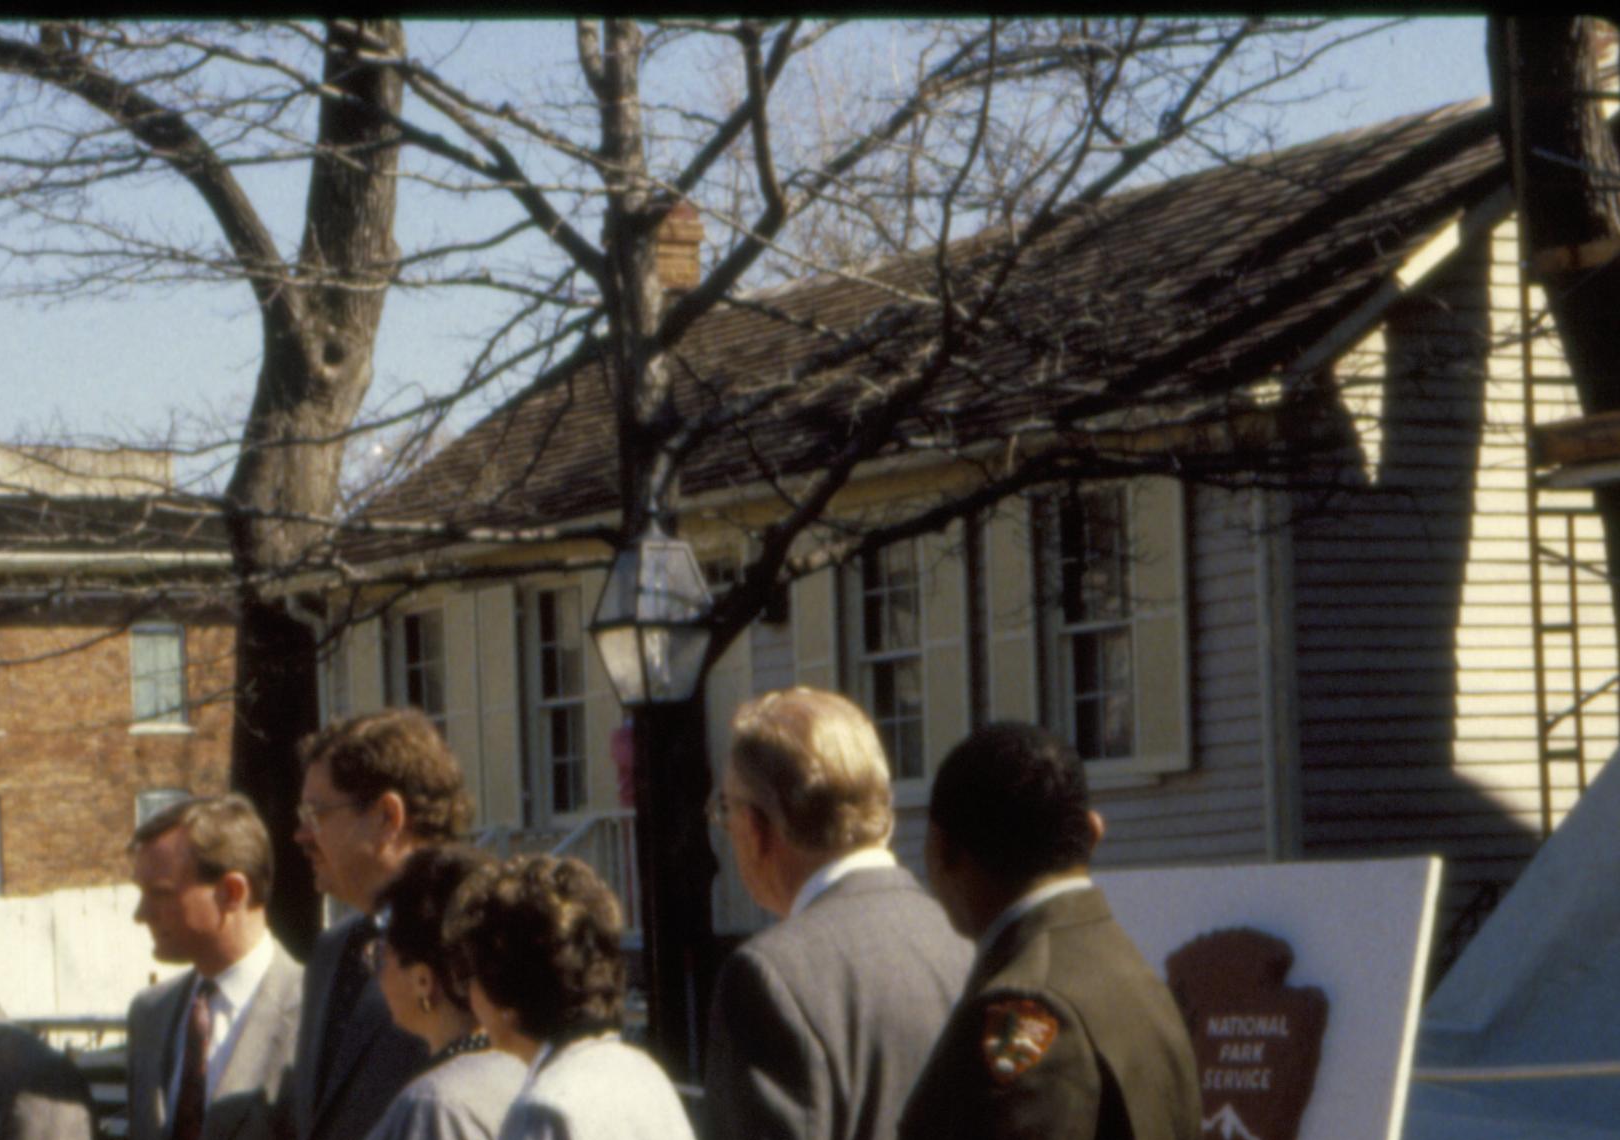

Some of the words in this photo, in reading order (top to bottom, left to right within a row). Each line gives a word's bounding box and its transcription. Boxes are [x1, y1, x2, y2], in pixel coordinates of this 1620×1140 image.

[1207, 1015, 1289, 1036] NATIONAL
[1219, 1043, 1266, 1063] PARK
[1202, 1069, 1272, 1090] SERVICE
